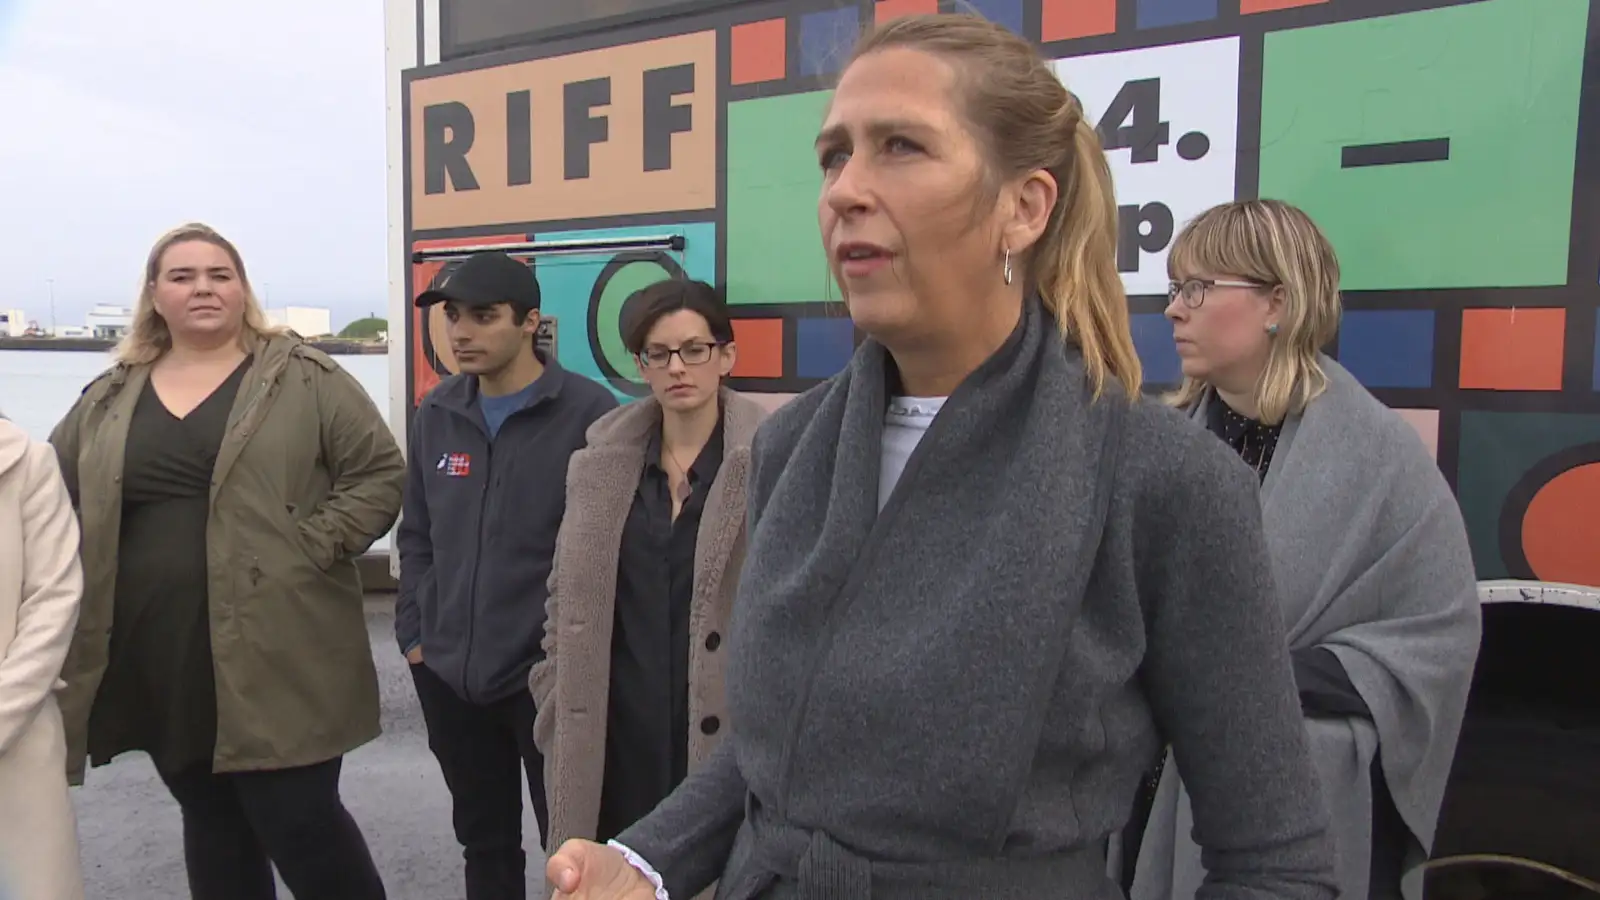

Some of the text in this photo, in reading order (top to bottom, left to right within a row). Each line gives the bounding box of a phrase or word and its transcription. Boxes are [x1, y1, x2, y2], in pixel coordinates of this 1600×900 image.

[424, 63, 695, 195] RIFF
[1069, 77, 1210, 164] 4.
[1117, 201, 1174, 272] p
